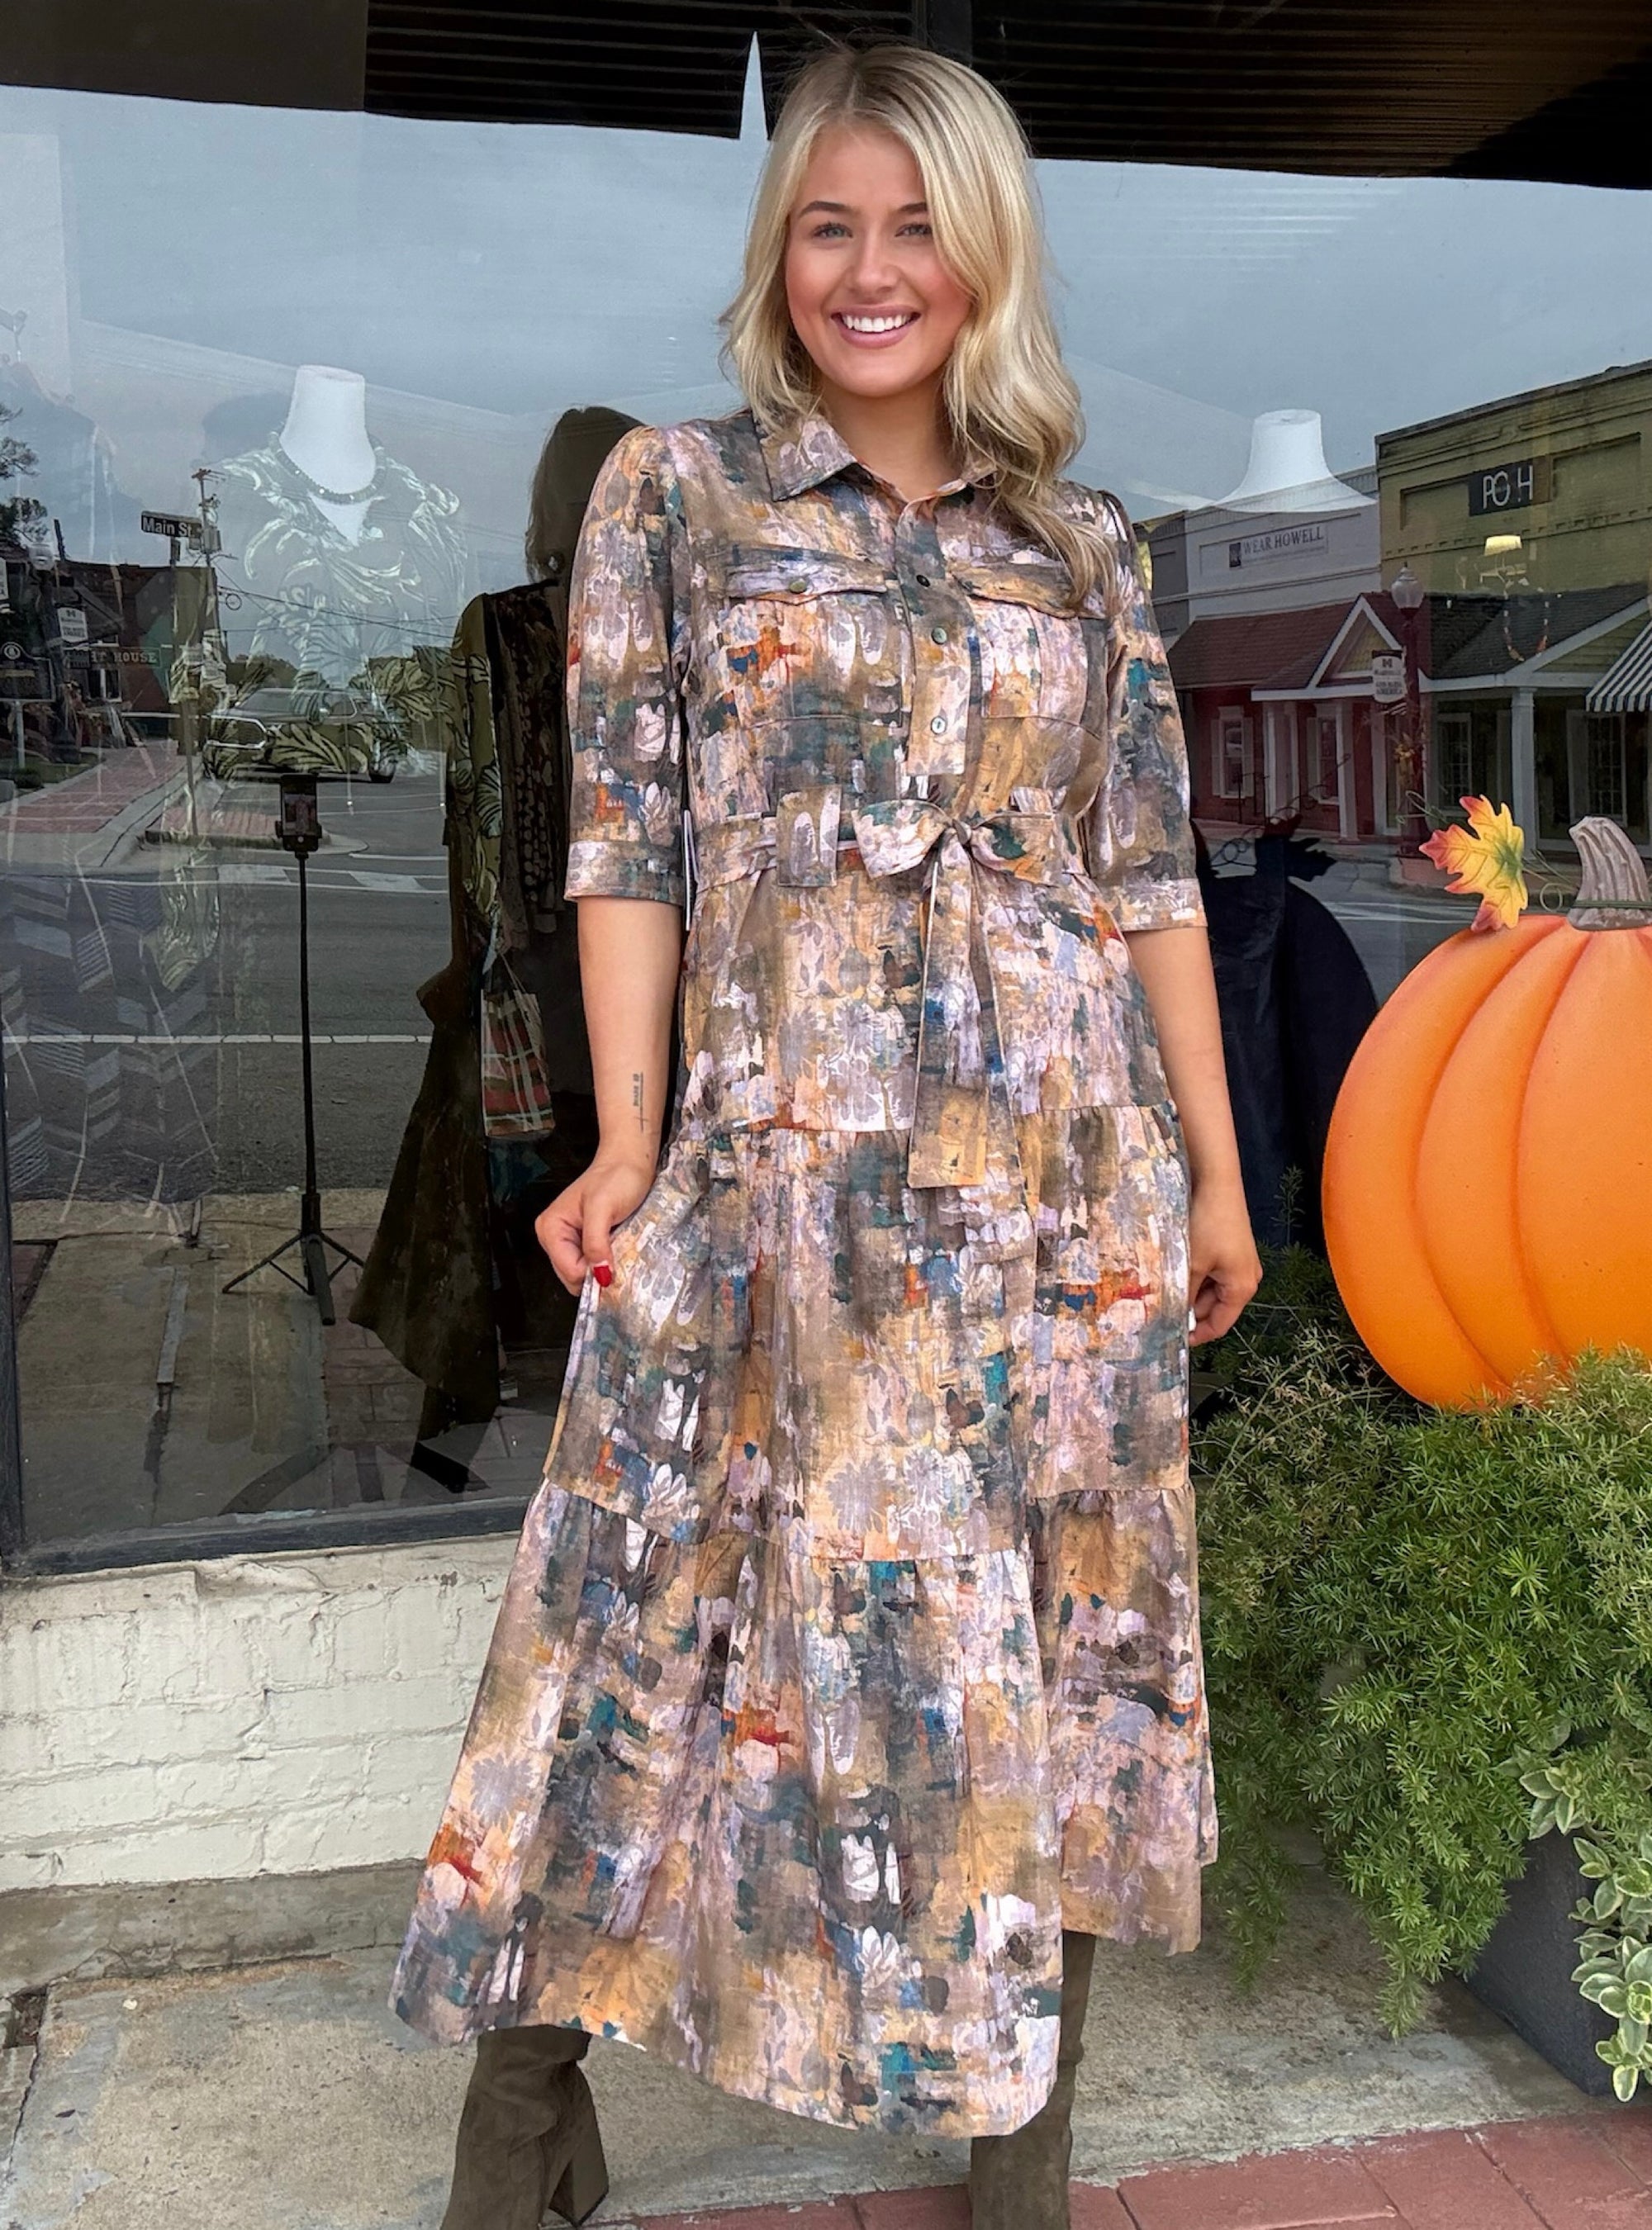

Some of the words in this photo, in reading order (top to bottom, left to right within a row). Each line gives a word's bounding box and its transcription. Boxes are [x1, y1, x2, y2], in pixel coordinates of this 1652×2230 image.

[143, 517, 176, 535] Main
[1243, 536, 1273, 555] WEAR
[1274, 526, 1324, 549] HOWELL
[115, 651, 157, 663] HOUSE
